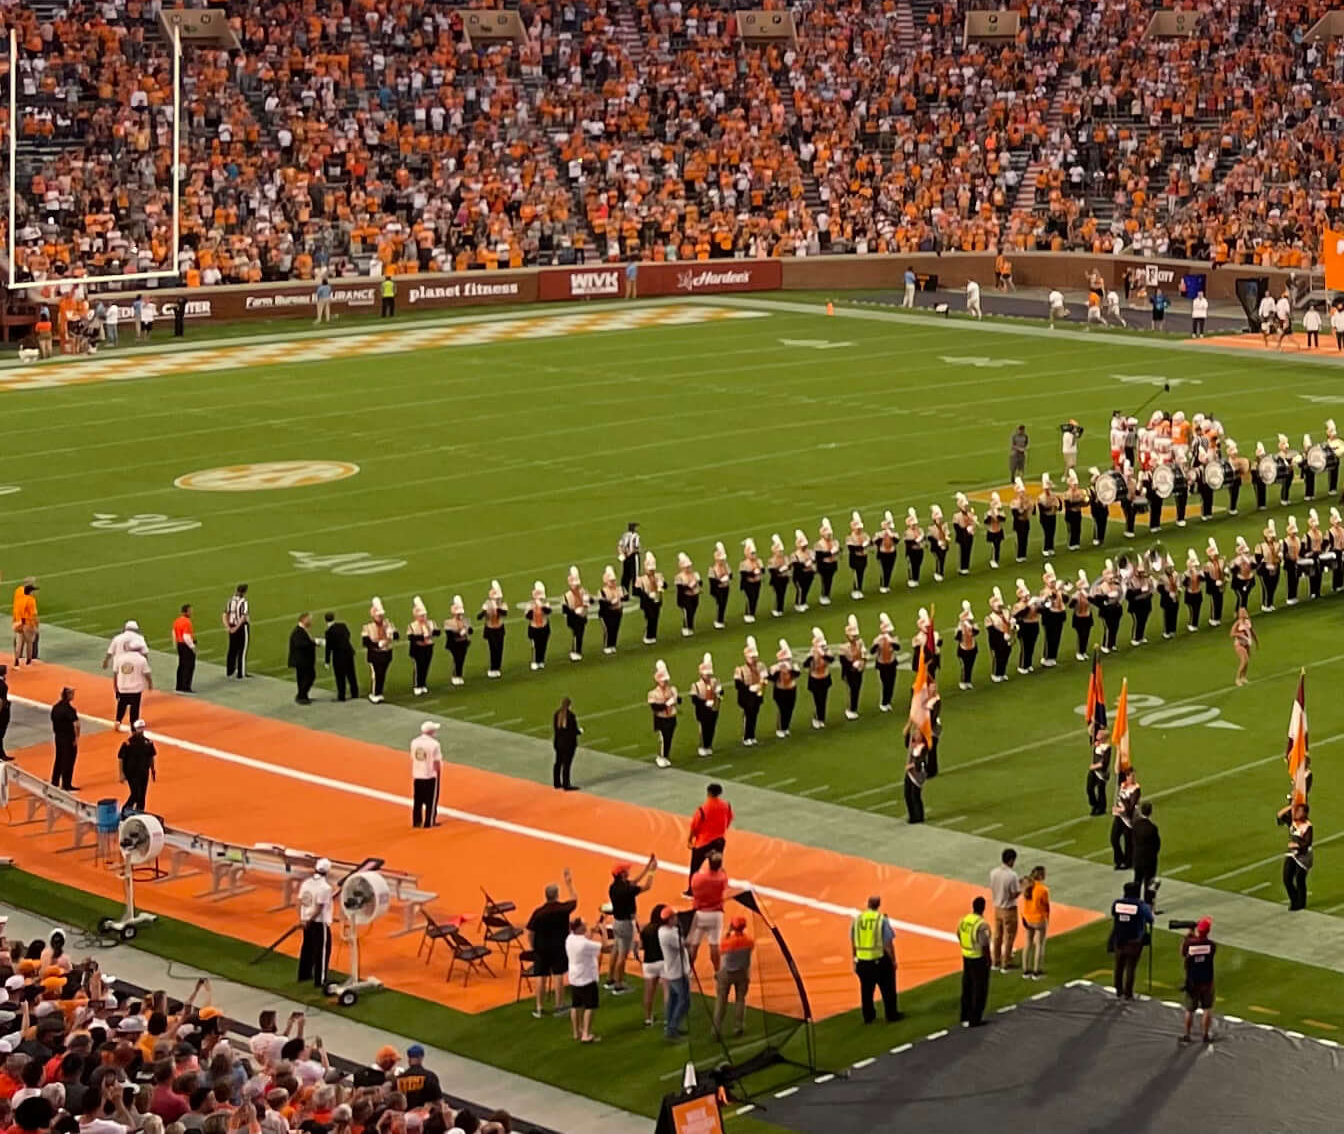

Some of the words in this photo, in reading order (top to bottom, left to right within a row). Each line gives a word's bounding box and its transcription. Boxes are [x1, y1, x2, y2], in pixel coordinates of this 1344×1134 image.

[571, 272, 619, 289] WIVK
[408, 285, 461, 303] planet
[464, 282, 518, 296] fitness
